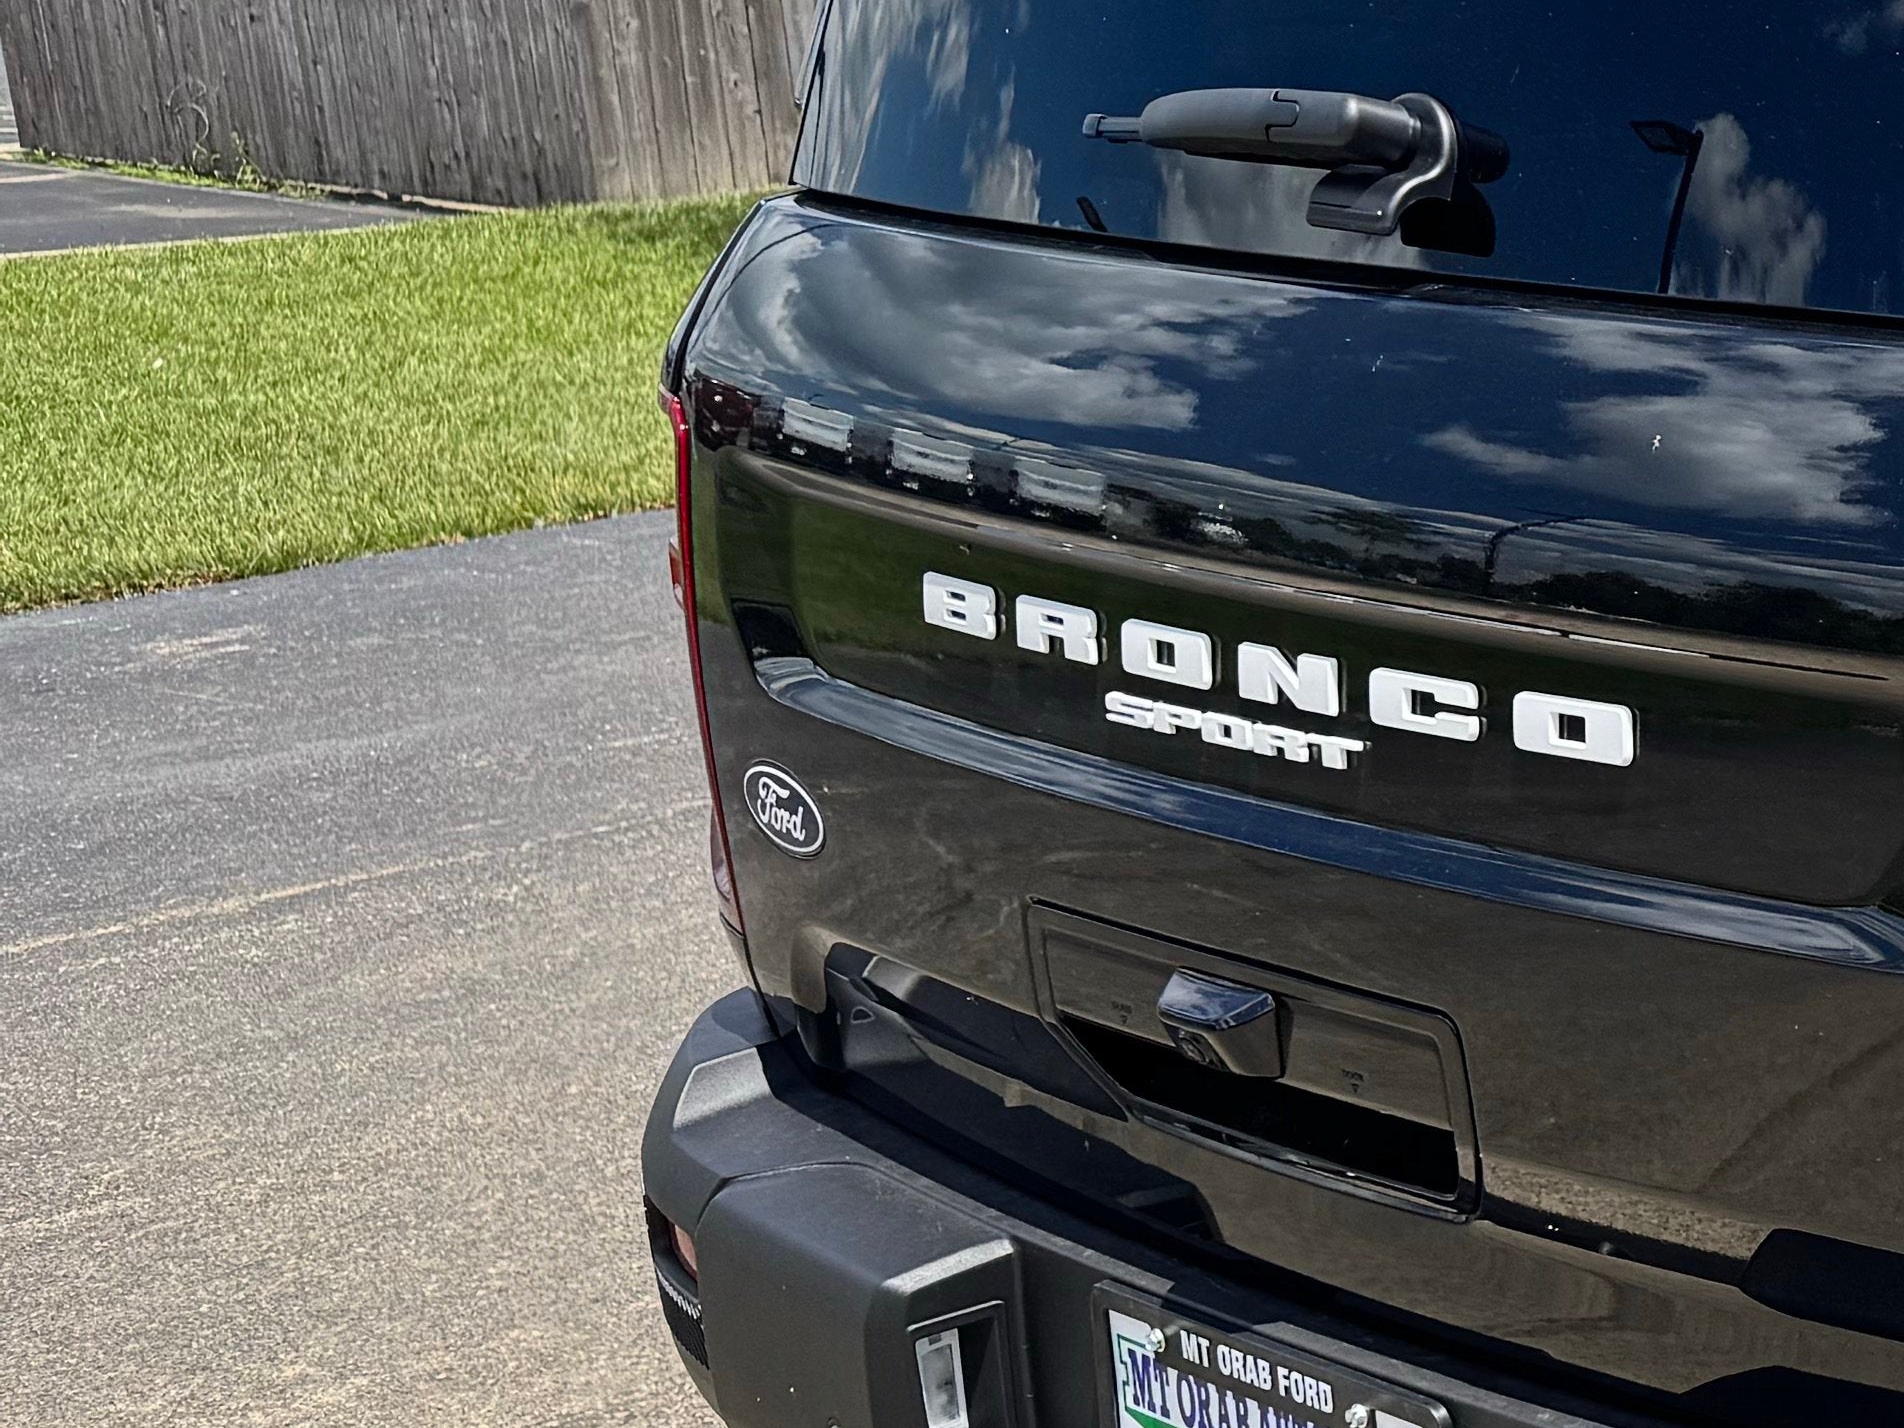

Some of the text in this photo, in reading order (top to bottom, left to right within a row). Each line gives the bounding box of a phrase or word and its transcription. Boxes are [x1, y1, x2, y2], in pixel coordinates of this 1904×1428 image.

[921, 570, 1635, 768] BRONCO
[1104, 690, 1371, 770] SPORT
[756, 775, 806, 843] Ford
[1127, 1347, 1171, 1420] MT
[1178, 1328, 1335, 1415] MT ORAB FORD
